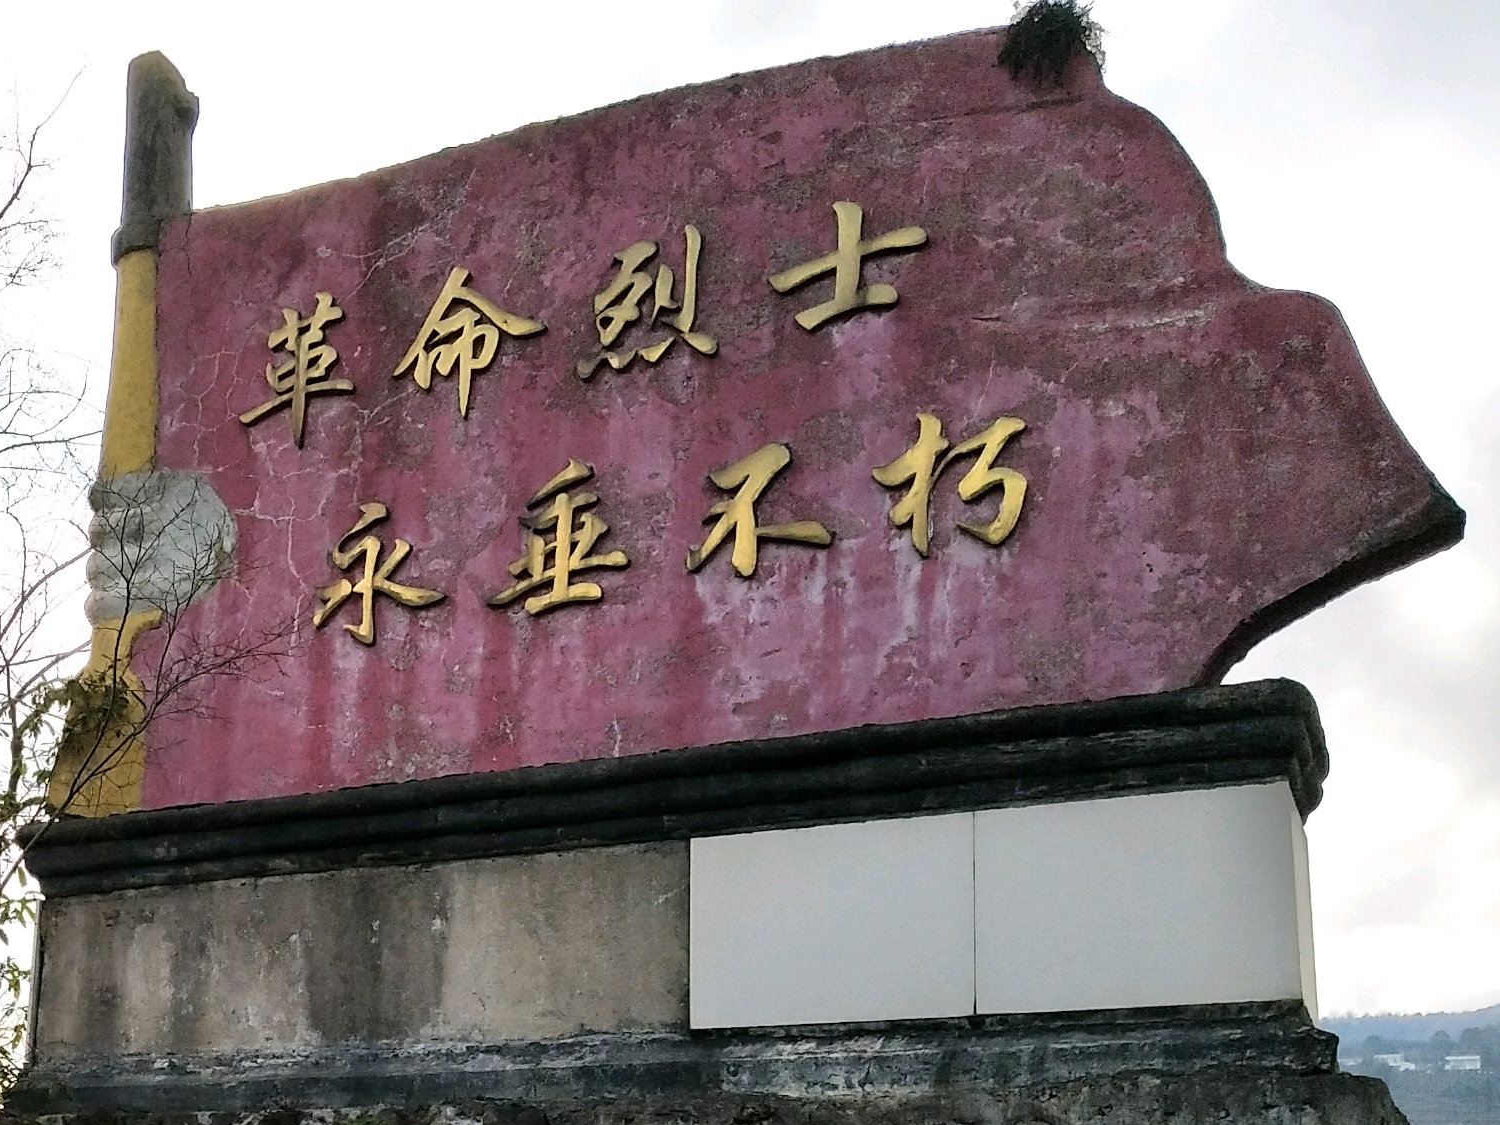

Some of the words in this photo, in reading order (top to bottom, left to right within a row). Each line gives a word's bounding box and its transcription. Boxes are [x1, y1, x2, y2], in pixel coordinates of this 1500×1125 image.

[239, 201, 929, 448] 革命烈士
[312, 413, 1028, 646] 永垂不朽
